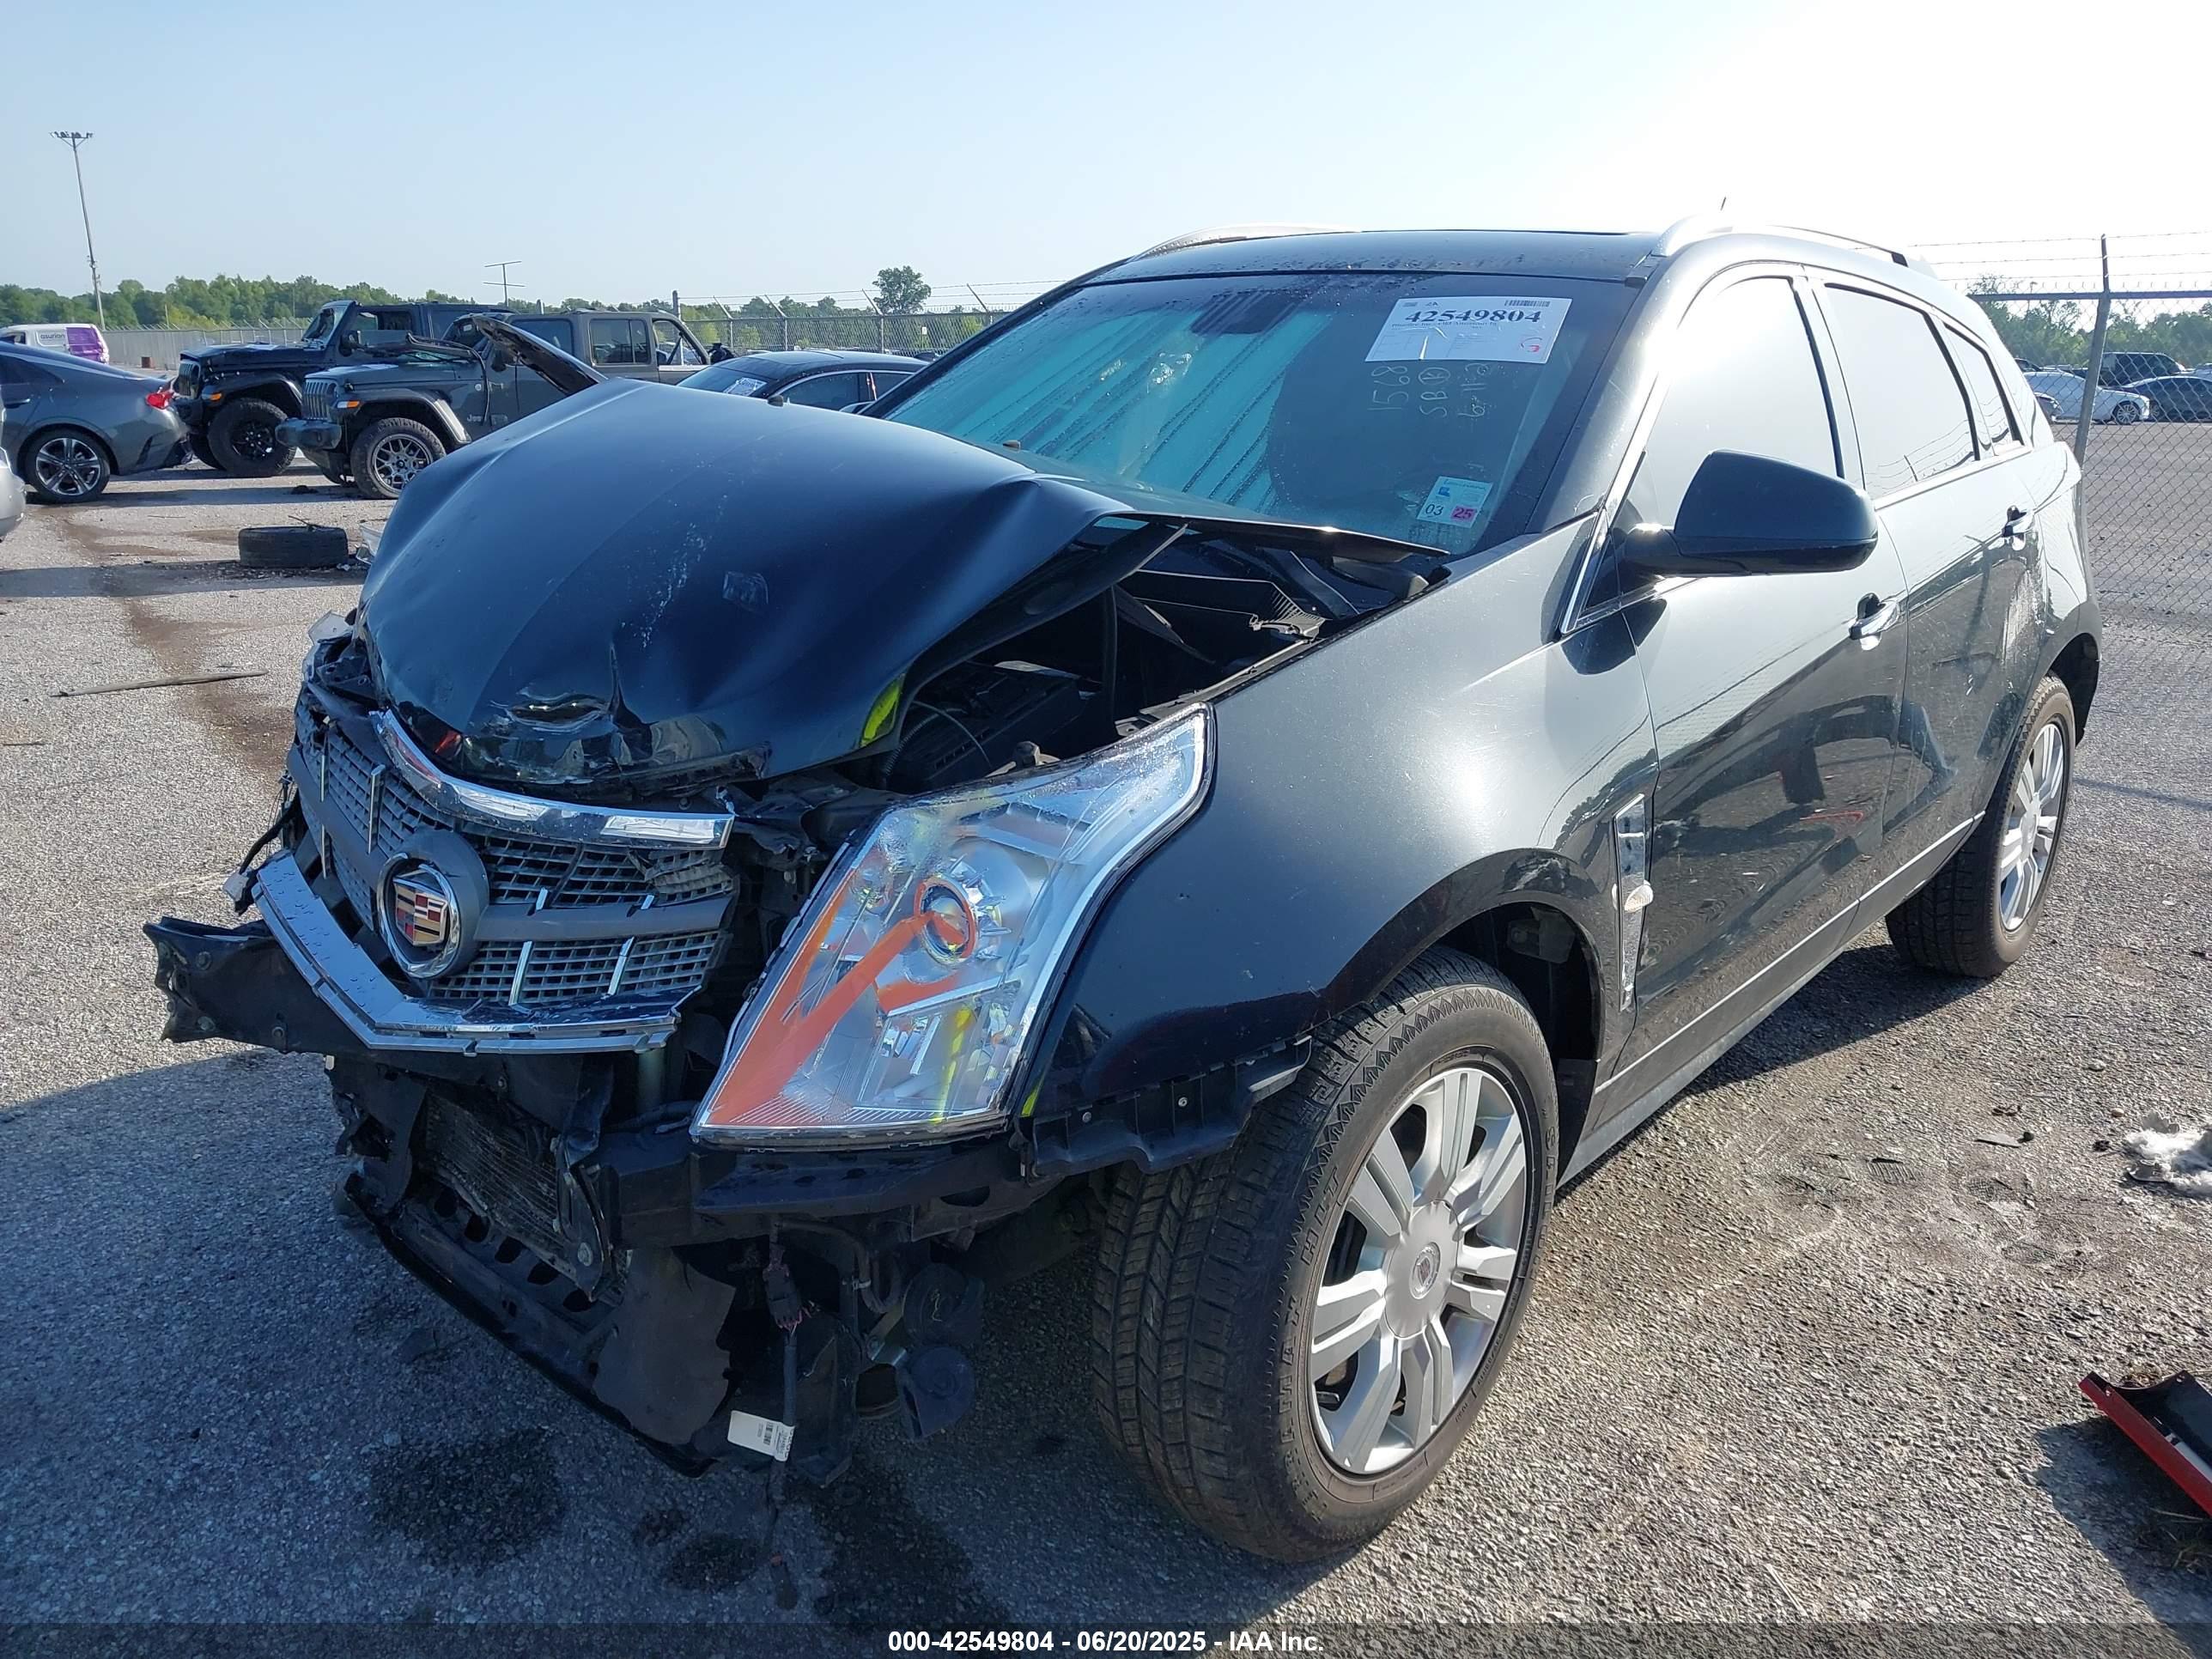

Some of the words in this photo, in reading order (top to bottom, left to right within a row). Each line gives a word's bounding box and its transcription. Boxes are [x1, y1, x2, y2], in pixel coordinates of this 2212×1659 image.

[1405, 309, 1541, 324] 42549804
[1425, 503, 1443, 516] 03
[1453, 507, 1475, 520] 25
